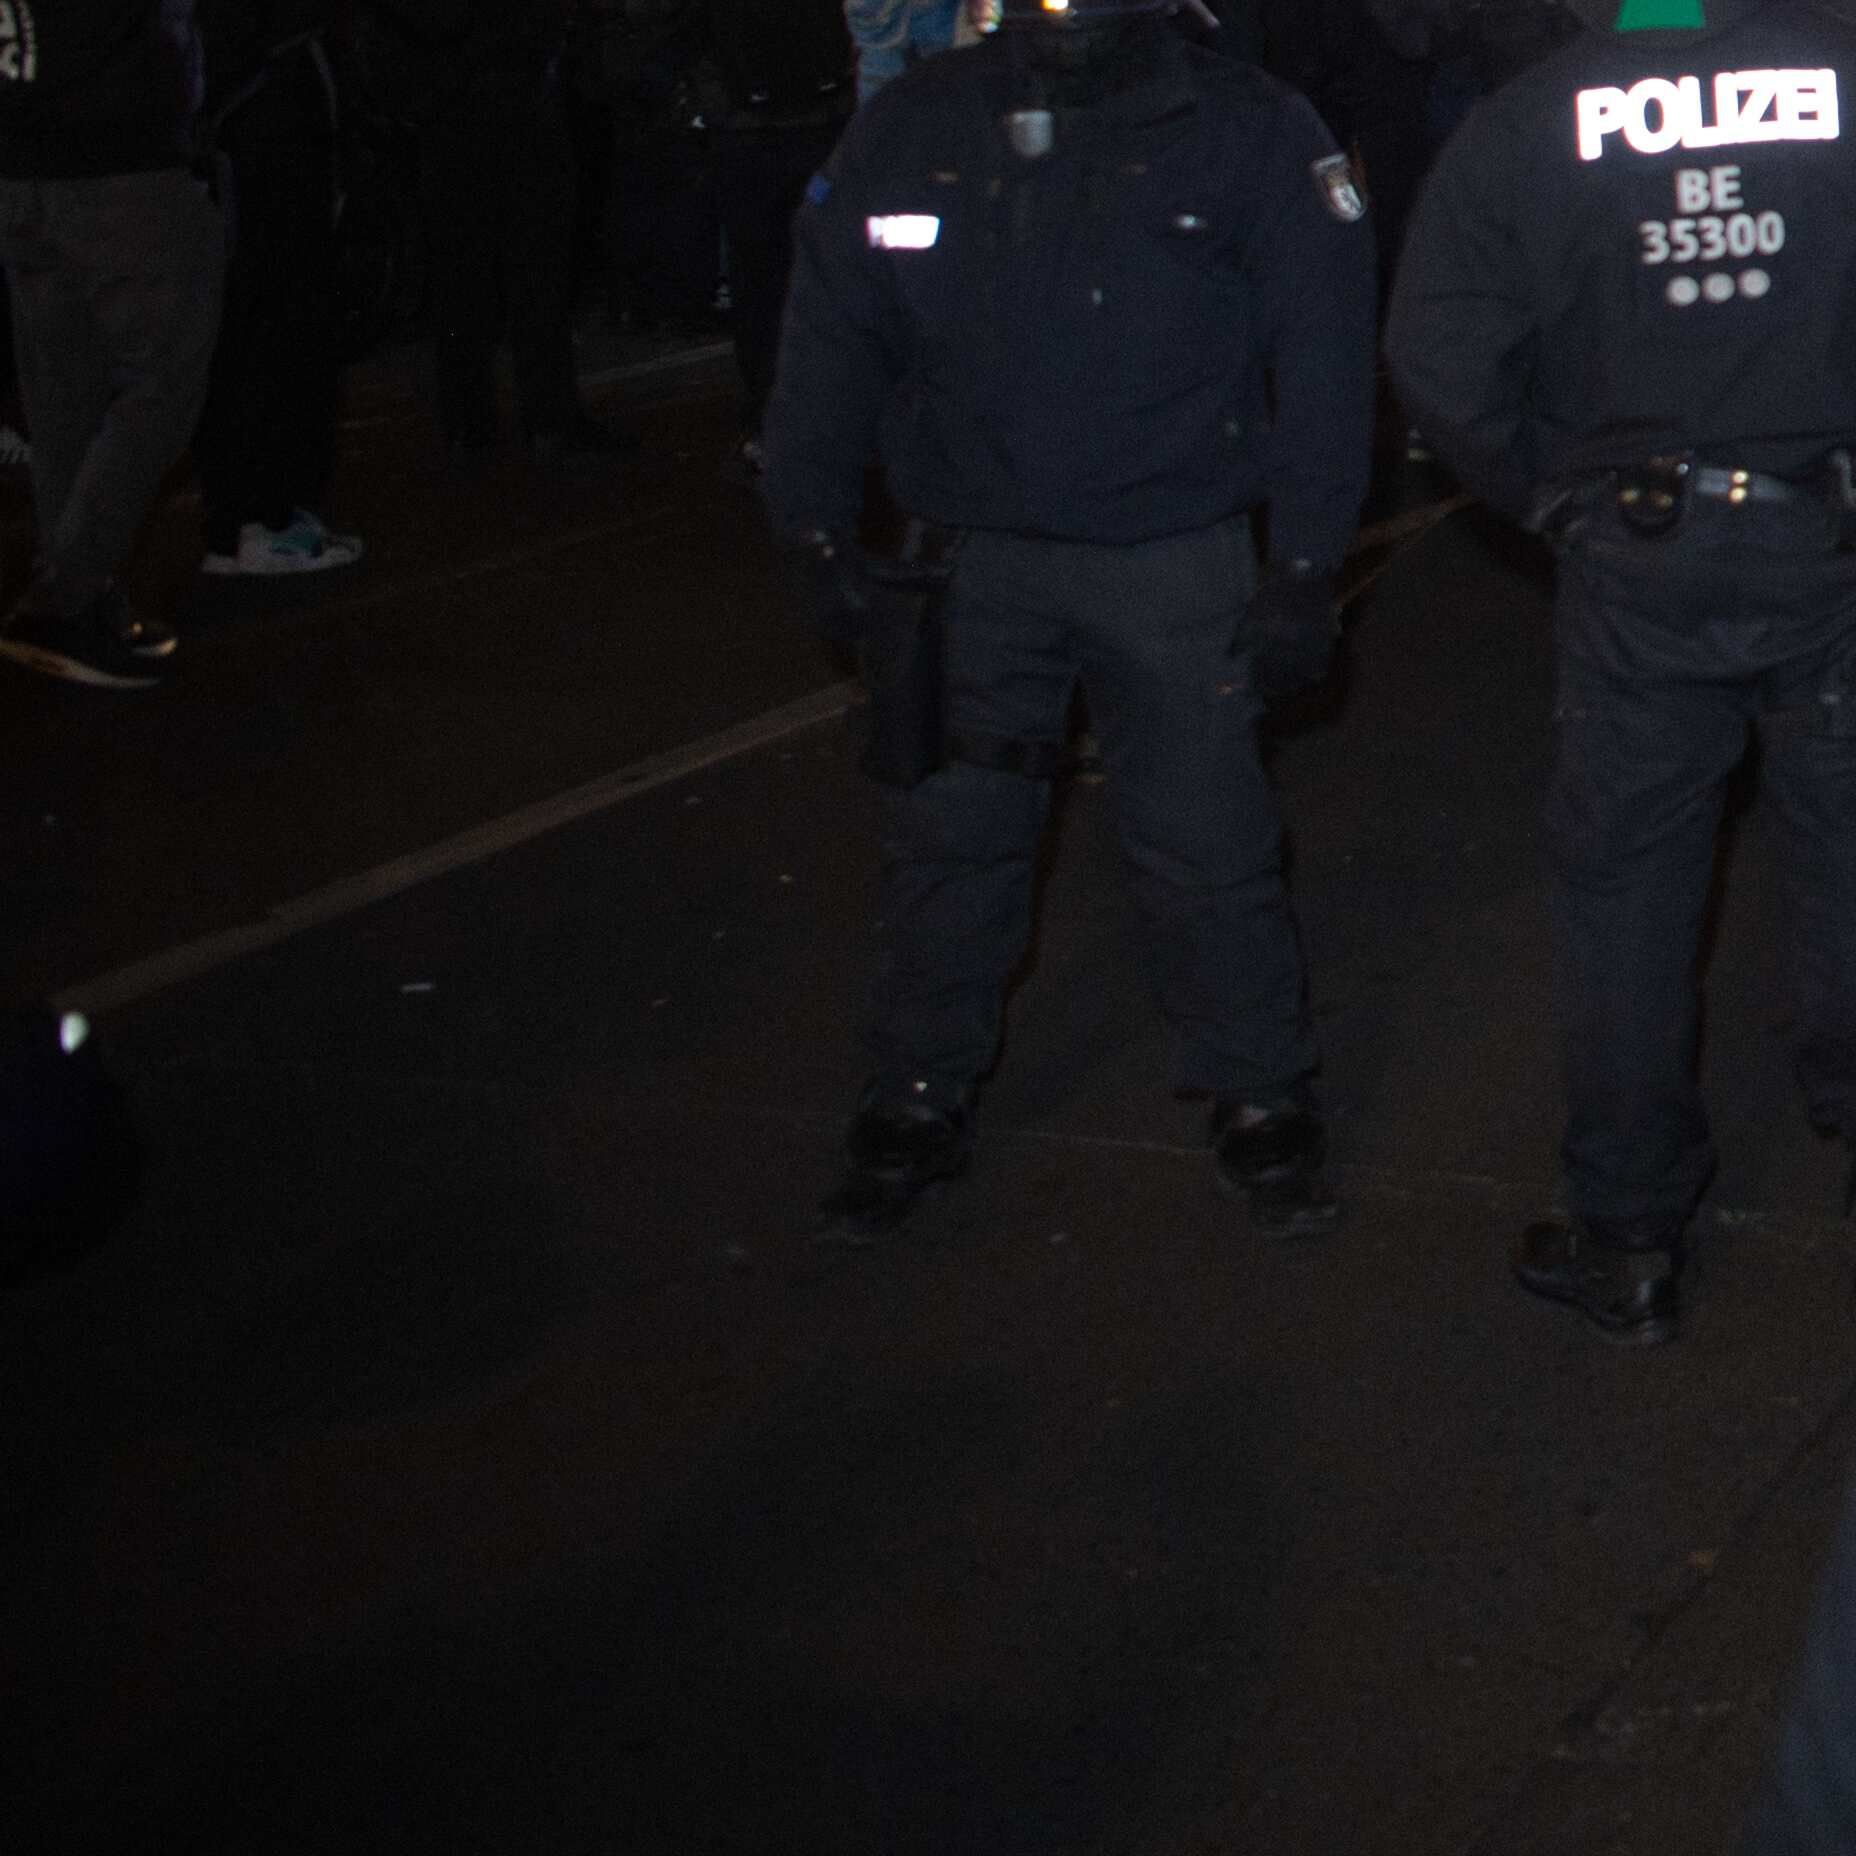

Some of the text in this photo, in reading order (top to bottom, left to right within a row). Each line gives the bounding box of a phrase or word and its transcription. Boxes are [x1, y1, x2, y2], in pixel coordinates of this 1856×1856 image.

[1576, 68, 1840, 161] POLIZEI
[1676, 165, 1744, 214] BE
[1638, 211, 1785, 264] 35300
